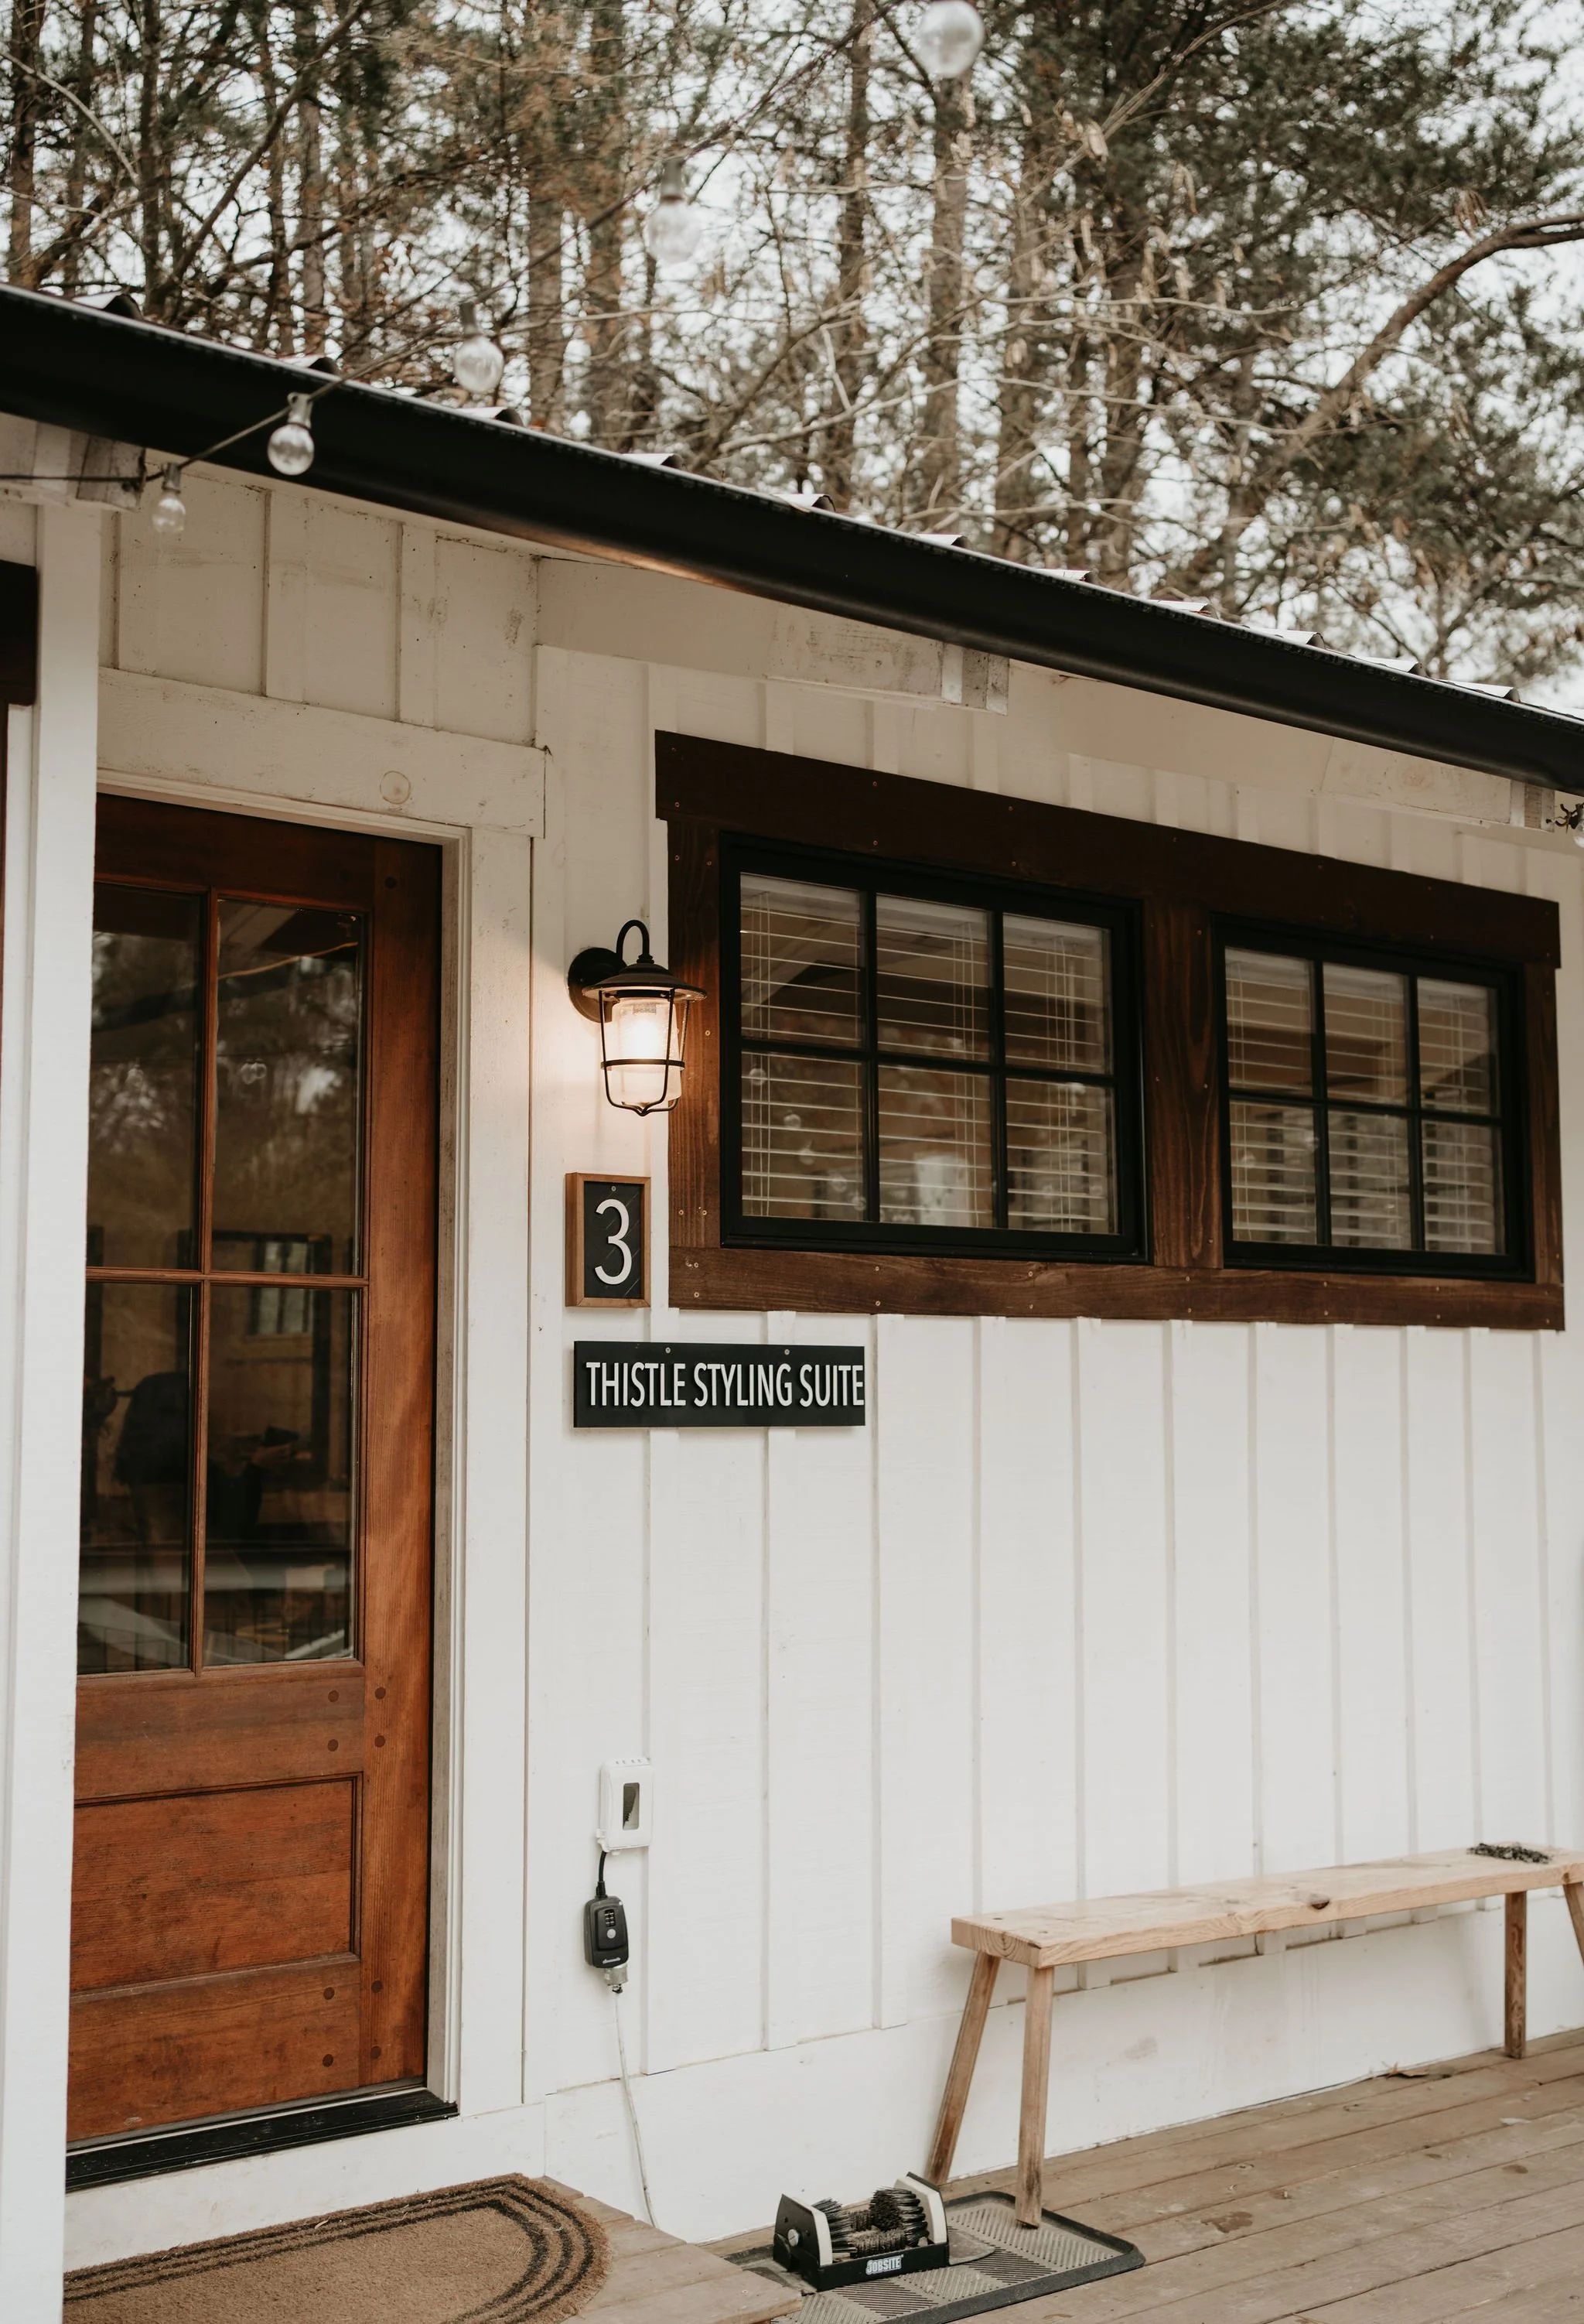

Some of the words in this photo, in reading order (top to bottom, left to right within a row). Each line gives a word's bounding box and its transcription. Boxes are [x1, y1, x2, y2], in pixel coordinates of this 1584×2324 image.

[594, 1198, 633, 1285] 3
[585, 1362, 687, 1406] THISTLE
[694, 1363, 793, 1406] STYLING
[799, 1364, 865, 1406] SUITE
[865, 2255, 902, 2275] JOBSITE
